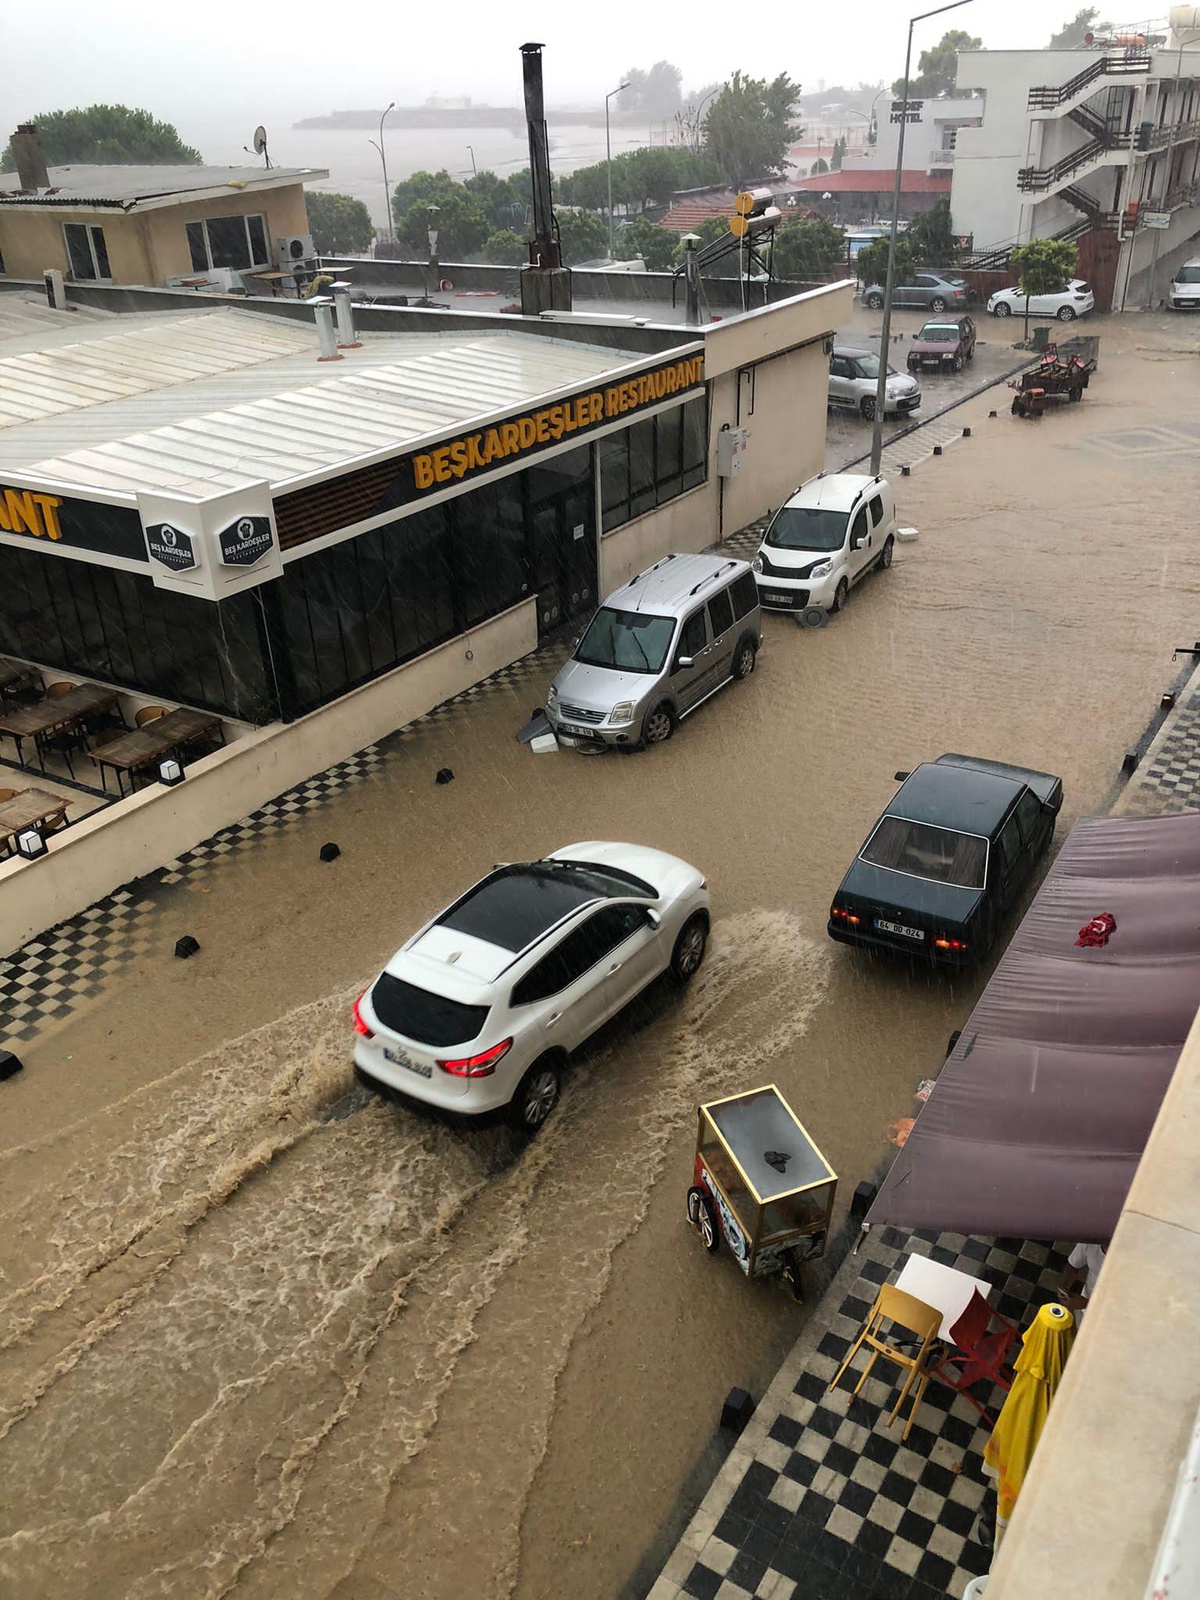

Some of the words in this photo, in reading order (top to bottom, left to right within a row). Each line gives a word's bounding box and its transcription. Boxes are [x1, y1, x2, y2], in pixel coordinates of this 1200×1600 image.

[890, 112, 923, 124] HOTEL
[604, 355, 704, 418] RESTAURANT
[150, 542, 161, 553] BEŞ
[161, 544, 192, 559] KARDEŞLER
[224, 544, 237, 556] BEŞ
[236, 533, 270, 550] KARDEŞLER
[880, 920, 889, 930] 64
